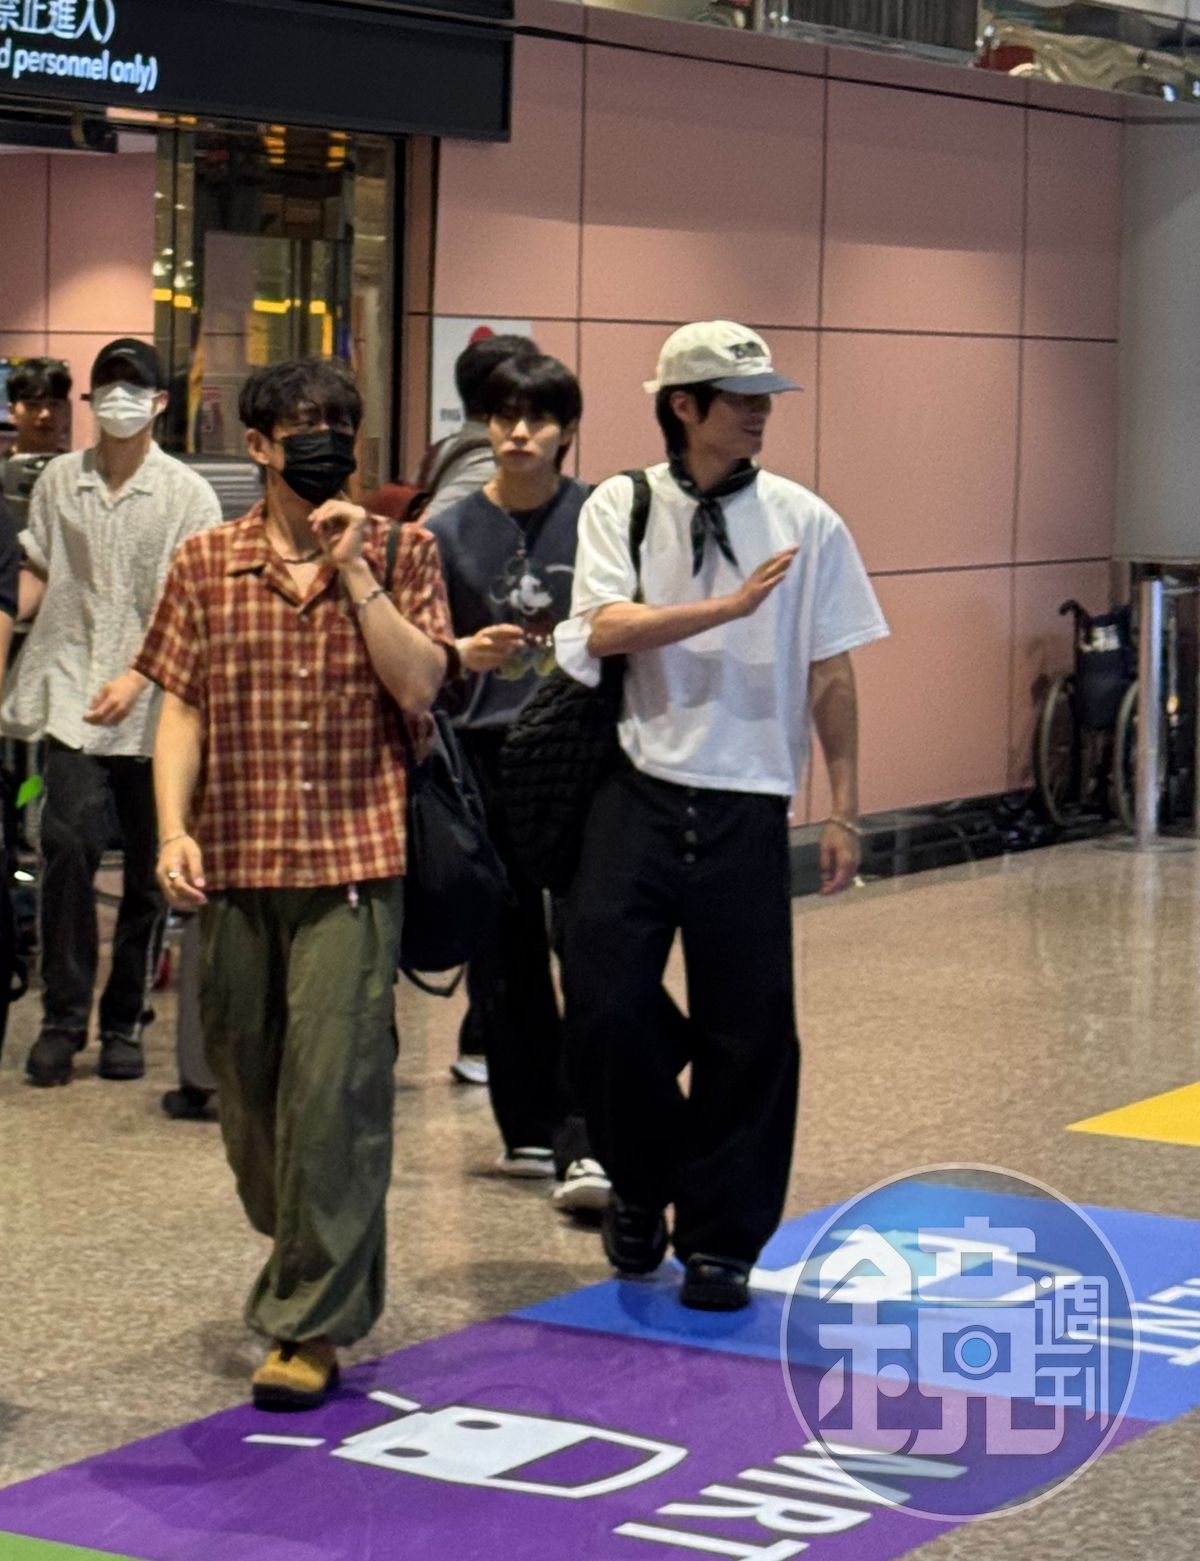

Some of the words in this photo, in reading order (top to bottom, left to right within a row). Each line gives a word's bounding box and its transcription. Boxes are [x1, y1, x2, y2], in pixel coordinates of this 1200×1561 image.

[11, 49, 110, 79] personnel
[110, 53, 158, 94] only)
[613, 1440, 970, 1561] MRT
